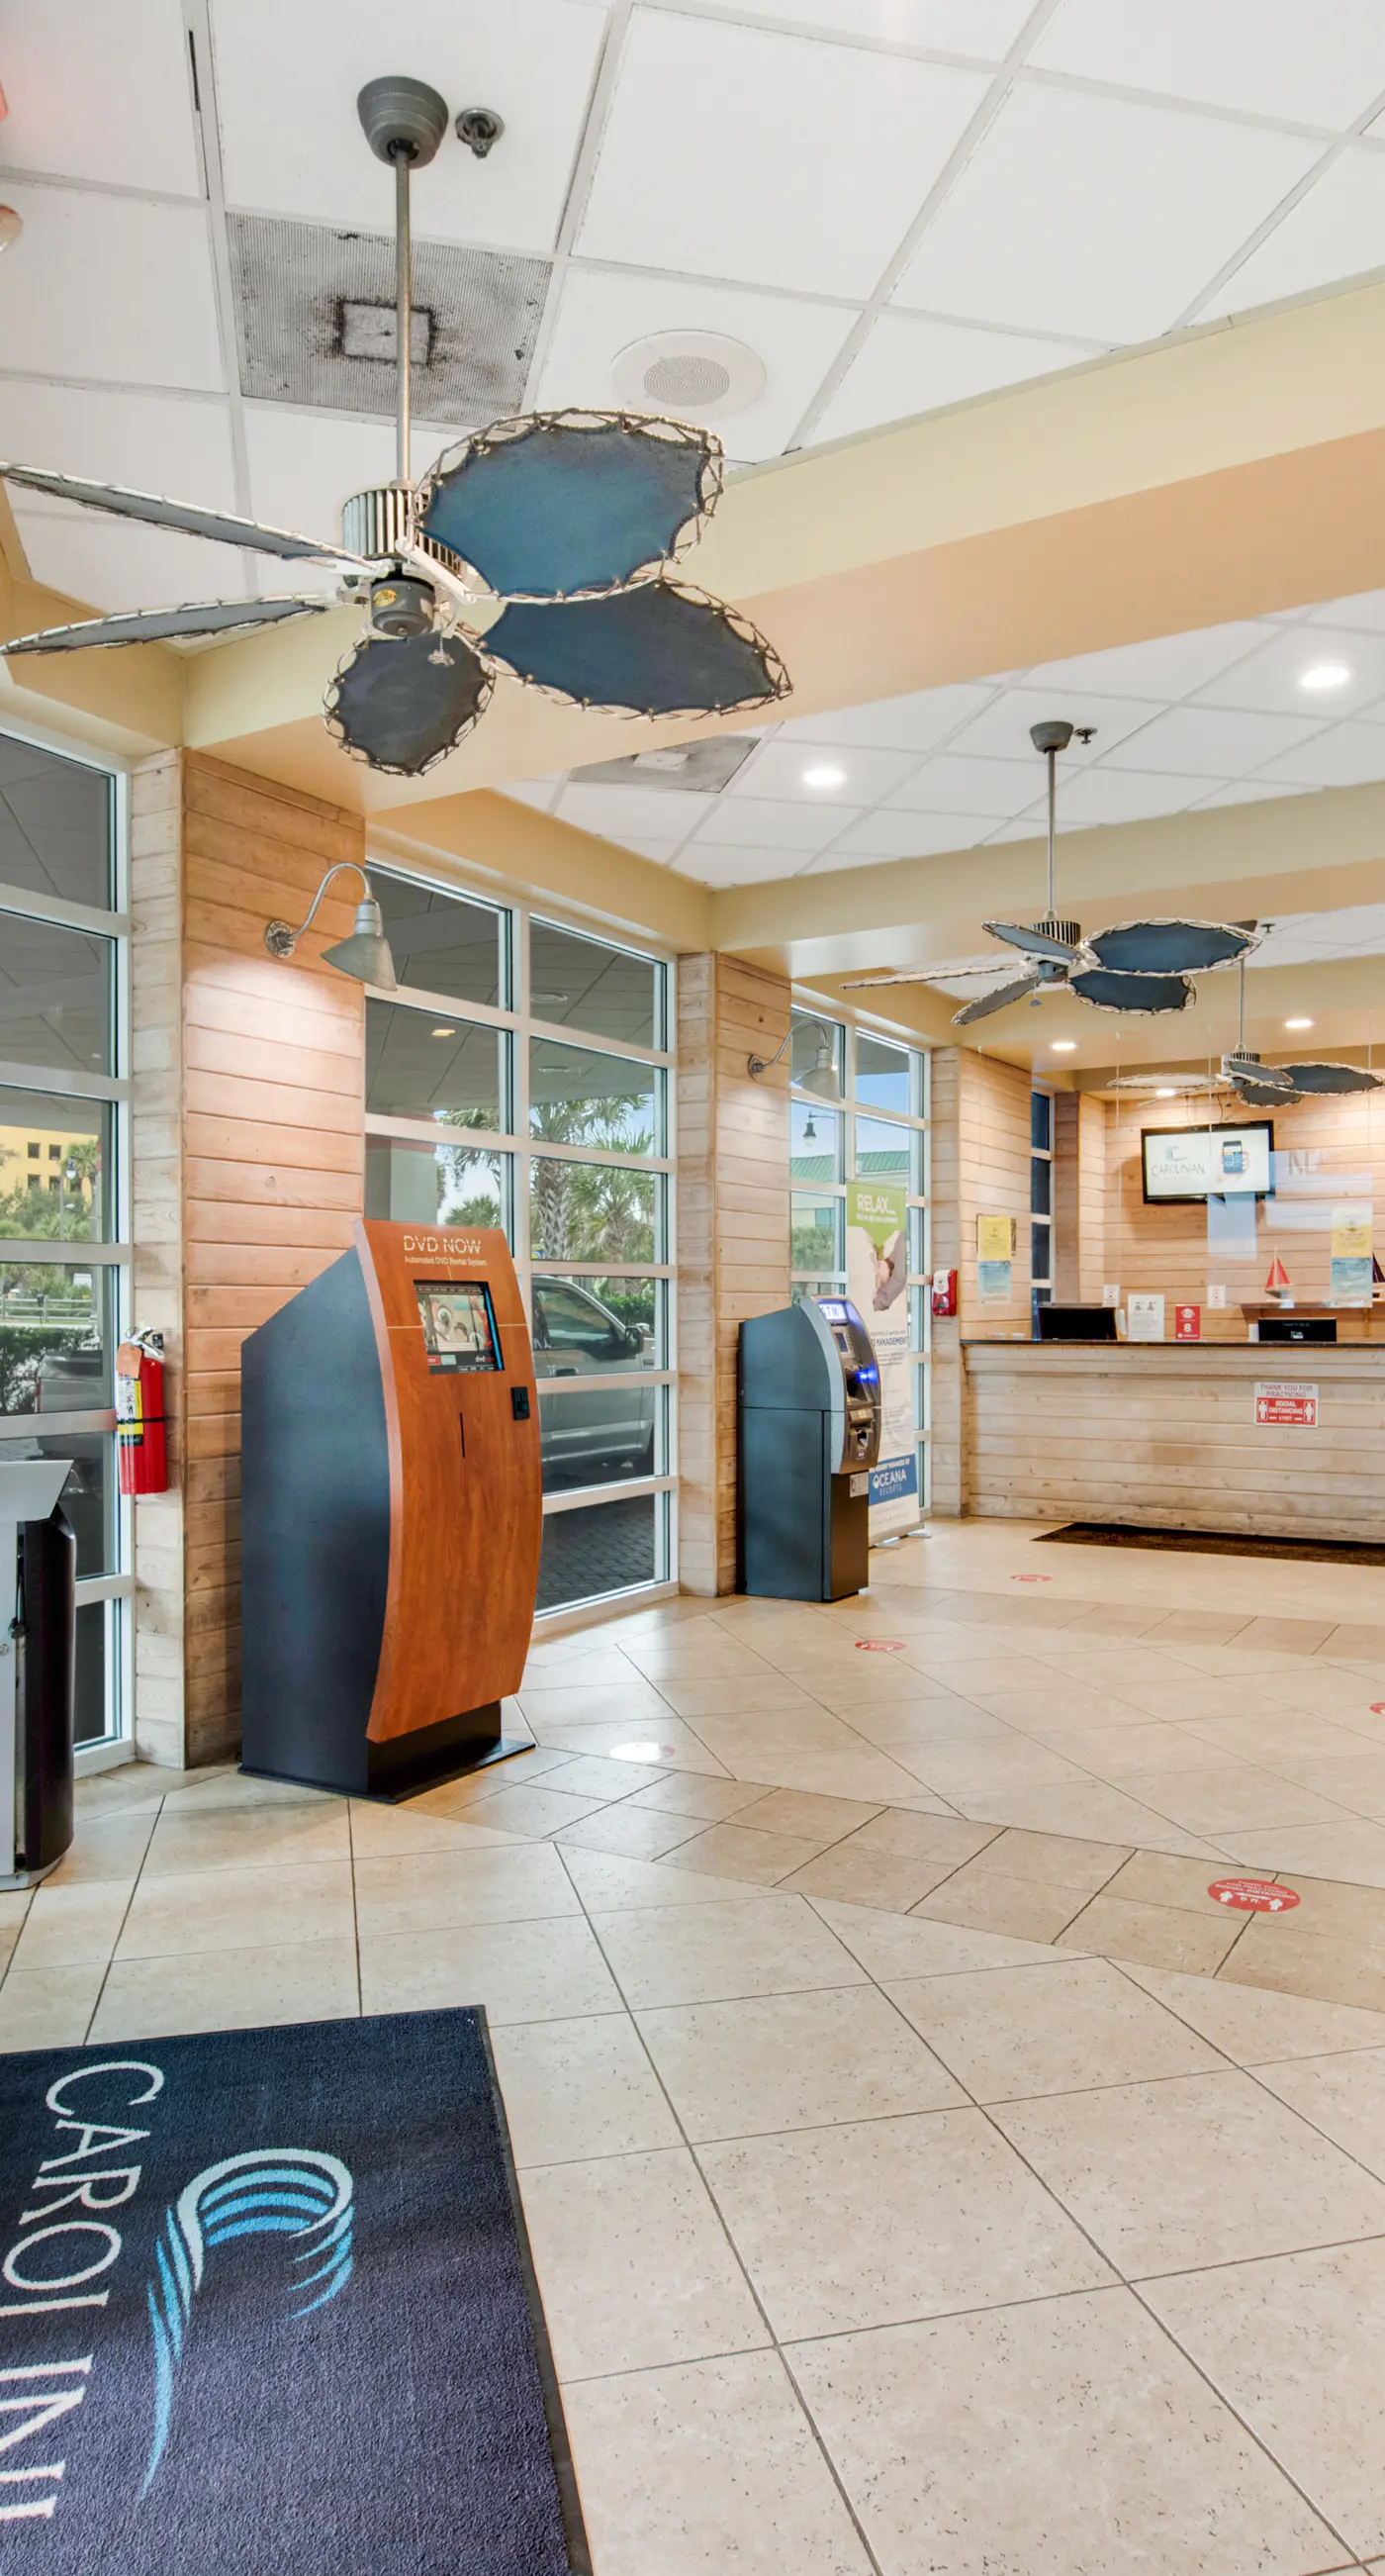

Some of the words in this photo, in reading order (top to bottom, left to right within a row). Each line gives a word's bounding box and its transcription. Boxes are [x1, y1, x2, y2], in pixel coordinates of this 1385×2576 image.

[1152, 1163, 1205, 1177] CAROLINIAN
[404, 1235, 438, 1252] DVD
[443, 1237, 481, 1254] NOW
[435, 1257, 449, 1266] DVD
[1269, 1406, 1304, 1415] DISTANCING
[873, 1469, 907, 1489] OCEANA
